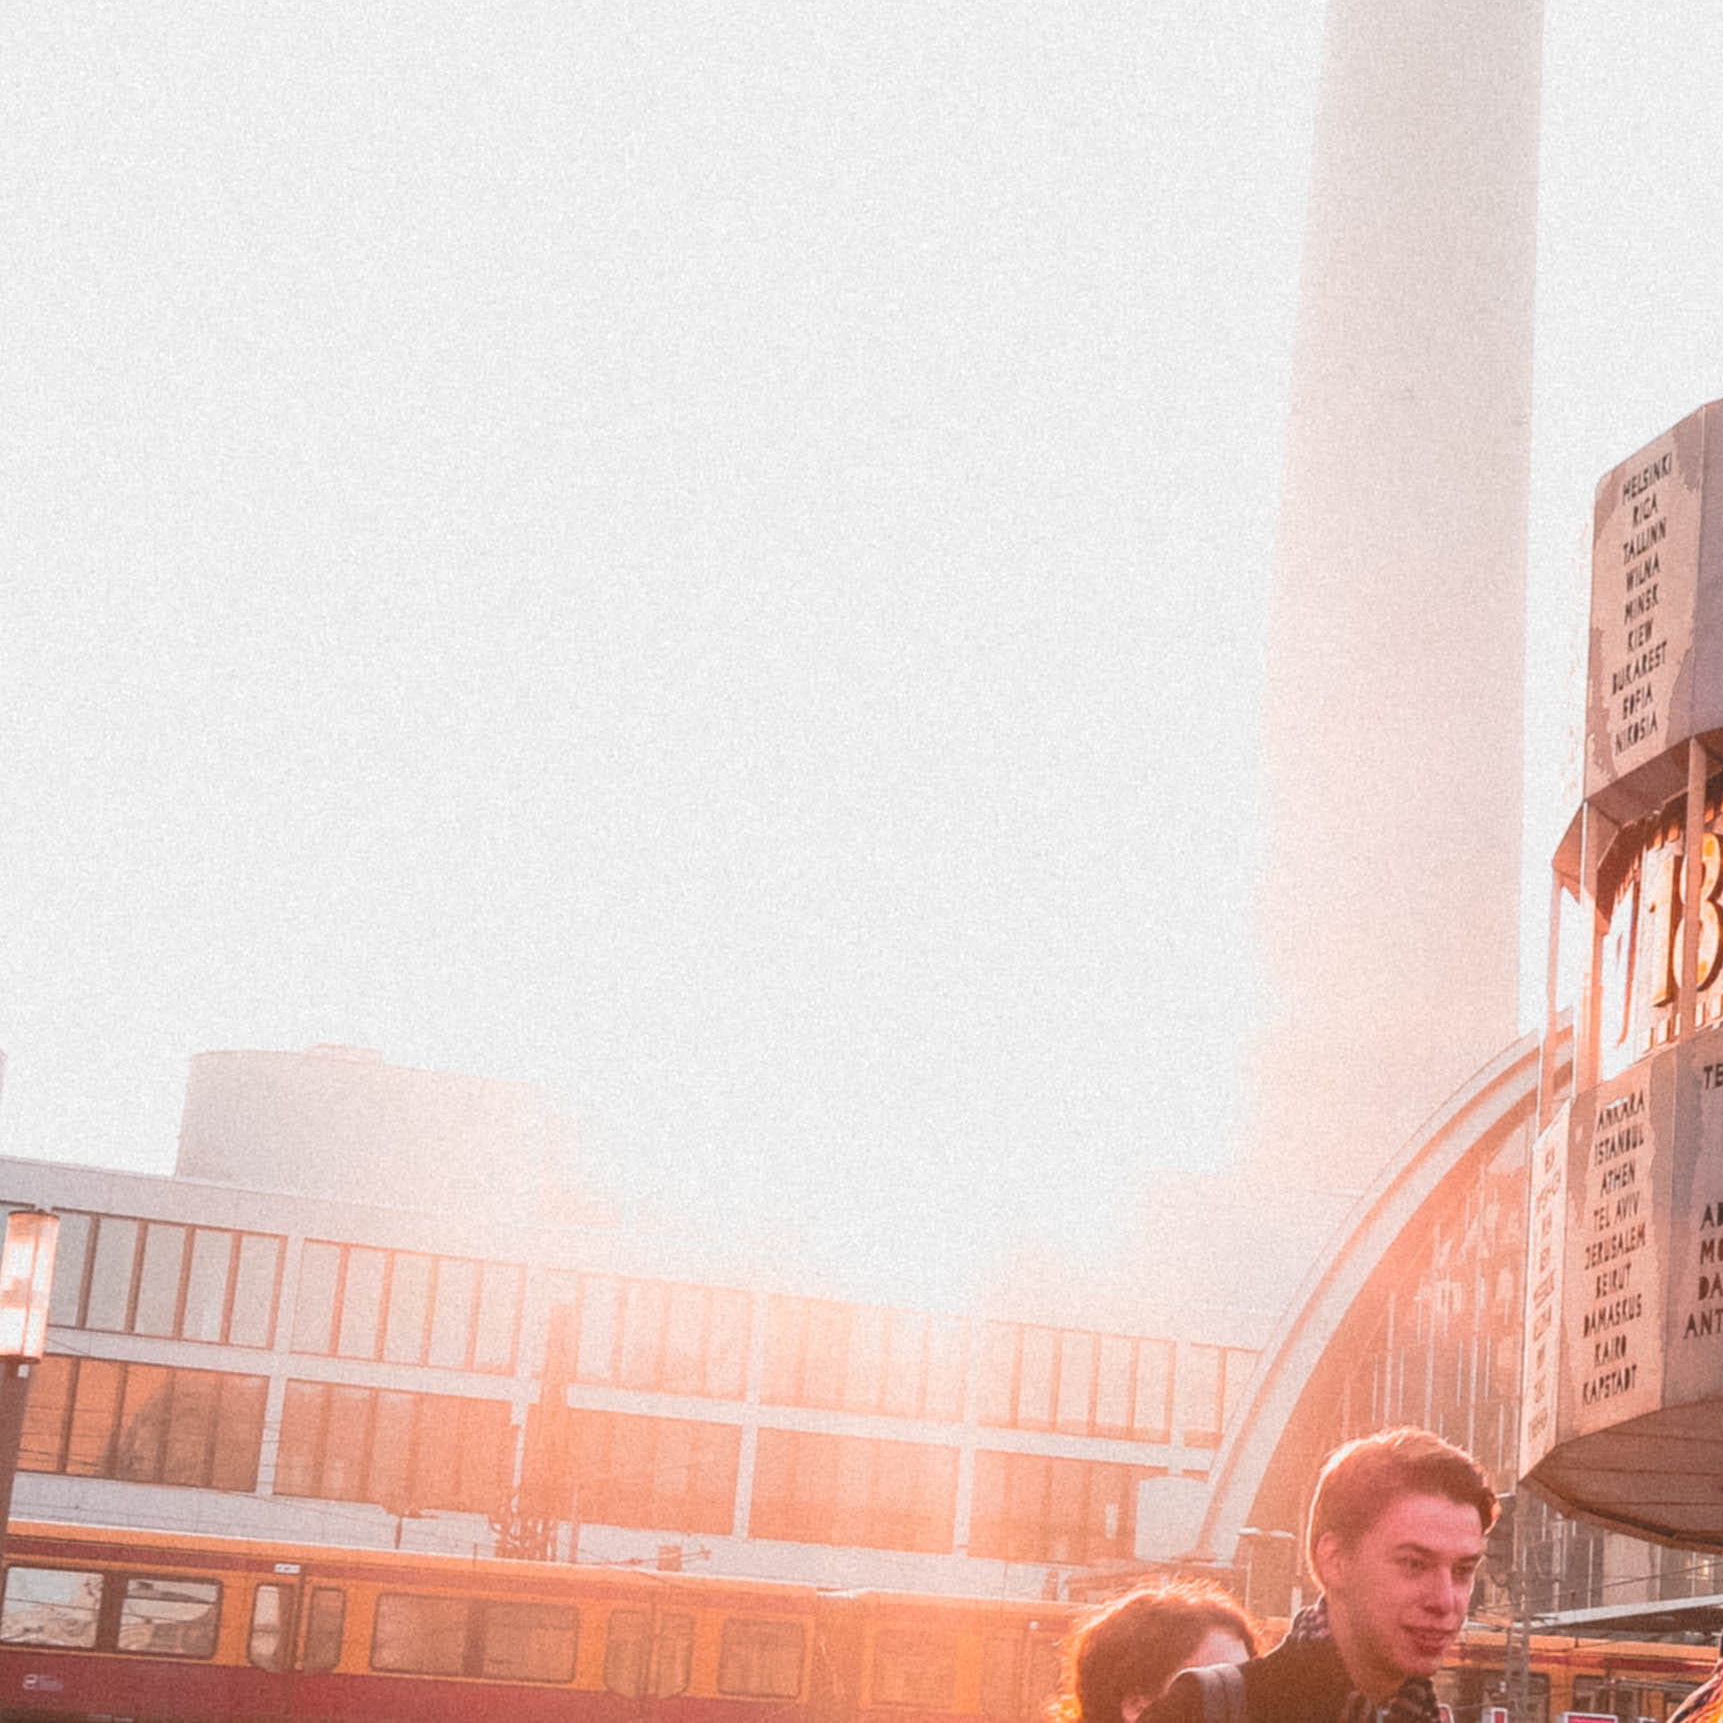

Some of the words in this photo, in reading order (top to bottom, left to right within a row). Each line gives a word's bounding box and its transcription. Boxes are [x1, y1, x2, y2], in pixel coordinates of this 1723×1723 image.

[1623, 453, 1673, 504] HELSINKI
[1633, 493, 1658, 526] RIGA
[1623, 517, 1667, 565] TALLINN
[1626, 552, 1660, 592] WILNA
[1624, 584, 1659, 625] MINSK
[1628, 618, 1653, 652] KIEW
[1612, 641, 1667, 694] BUKAREST
[1623, 688, 1653, 720] SOFIA
[1615, 719, 1658, 756] NIKOSIA
[1598, 1090, 1645, 1133] ANKARA
[1594, 1122, 1645, 1166] ISTANBUL
[1600, 1159, 1636, 1197] ATHEN
[1593, 1205, 1610, 1233] TEL
[1615, 1192, 1640, 1221] AVIV
[1584, 1223, 1646, 1271] JERUSALEM
[1595, 1263, 1632, 1300] BEIRUT
[1583, 1294, 1643, 1338] DAMASKUS
[1594, 1334, 1628, 1369] KAIRO
[1581, 1365, 1638, 1406] KAPSTADT
